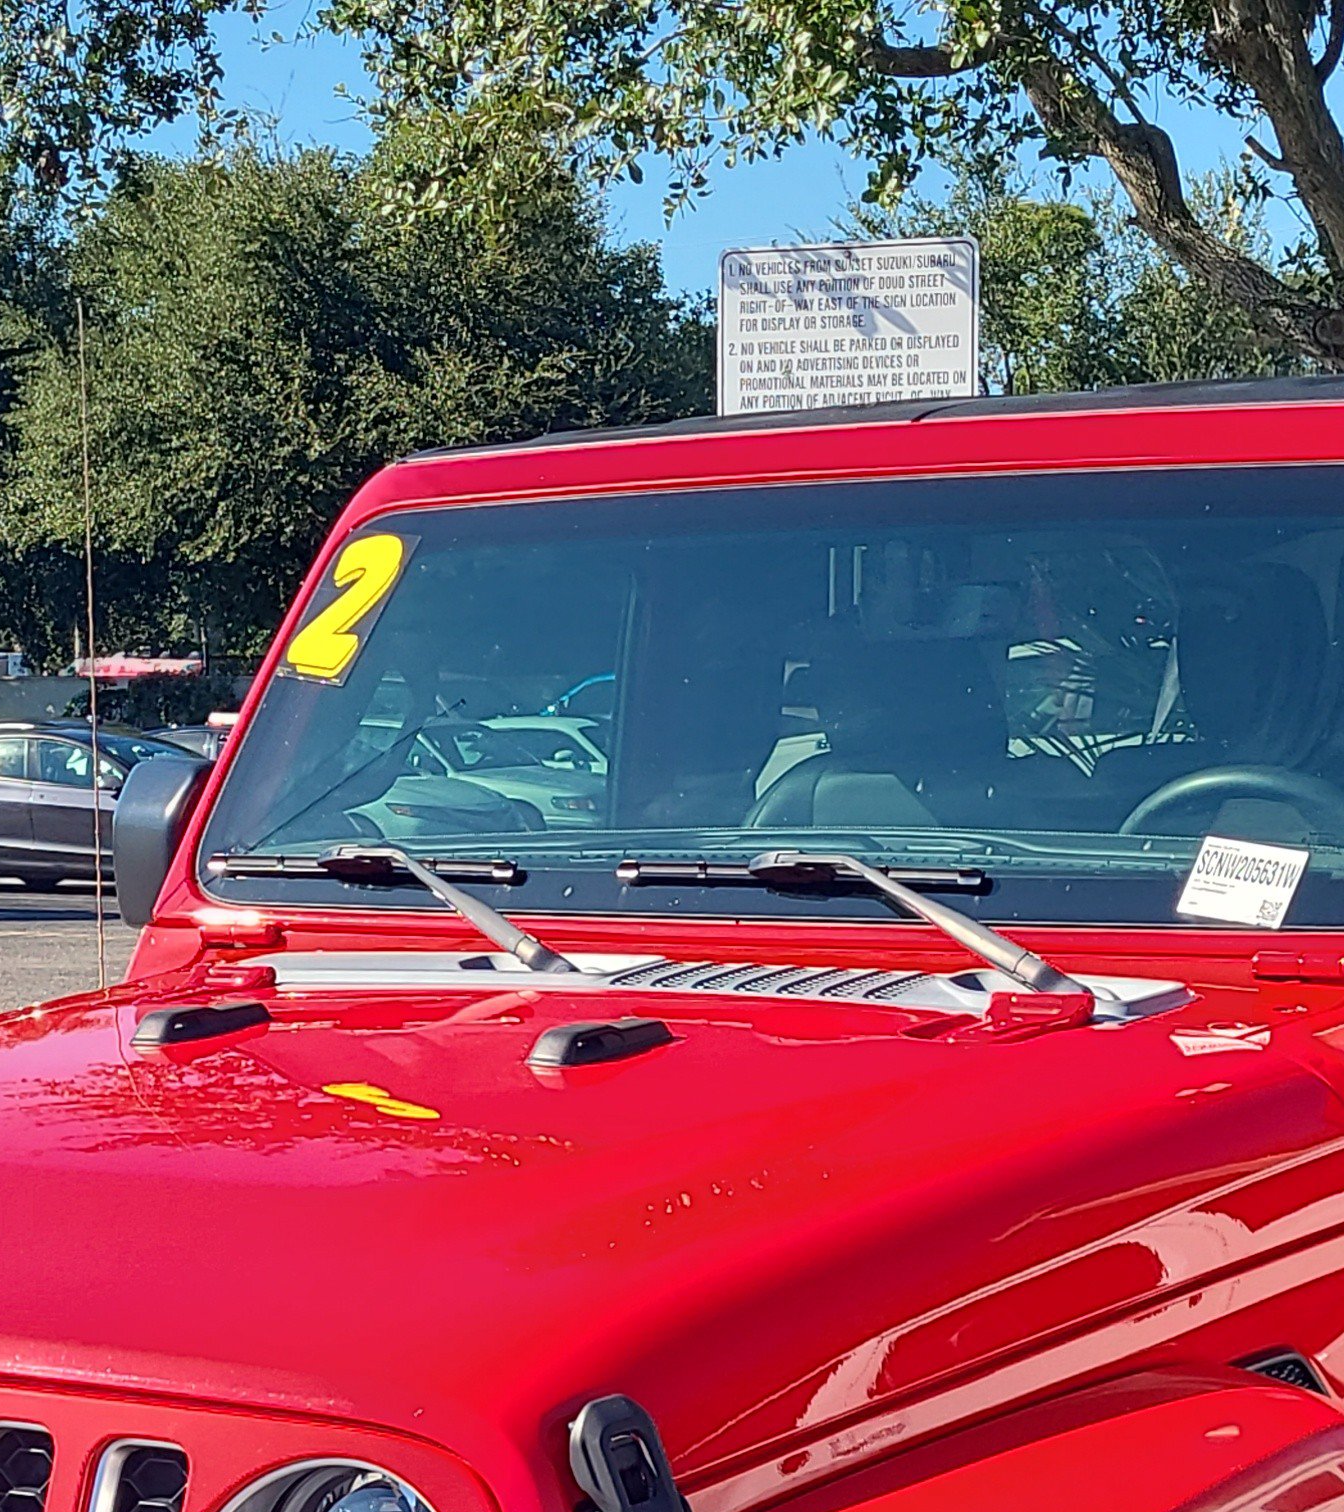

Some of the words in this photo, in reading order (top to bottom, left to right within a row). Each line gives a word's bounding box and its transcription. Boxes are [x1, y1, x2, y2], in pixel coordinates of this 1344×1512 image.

[739, 263, 752, 276] NO
[755, 260, 801, 275] VEHICLES
[803, 260, 831, 274] FROM
[834, 257, 873, 272] SUNSET
[740, 280, 771, 295] SHALL
[773, 280, 792, 294] USE
[796, 279, 815, 293] ANY
[819, 277, 859, 292] PORTION
[863, 276, 876, 290] OF
[878, 275, 905, 290] DOUD
[908, 274, 945, 288] STREET
[818, 297, 843, 311] EAST
[846, 296, 859, 310] OF
[862, 295, 880, 309] THE
[883, 294, 907, 308] SIGN
[910, 292, 956, 307] LOCATION
[740, 318, 758, 332] FOR
[761, 316, 801, 331] DISPLAY
[804, 316, 816, 330] OR
[729, 342, 737, 356] 2.
[741, 342, 754, 356] NO
[758, 340, 796, 355] VEHICLE
[800, 339, 829, 353] SHALL
[834, 338, 846, 352] BE
[849, 337, 887, 352] PARKED
[891, 336, 903, 350] OR
[907, 334, 960, 350] DISPLAYED
[740, 360, 753, 374] ON
[757, 359, 776, 373] AND
[779, 358, 793, 373] NO
[796, 356, 859, 371] ADVERTISING
[862, 354, 903, 369] DEVICES
[906, 353, 920, 368] OR
[740, 376, 806, 391] PROMOTIONAL
[810, 373, 864, 389] MATERIALS
[867, 372, 888, 387] MAY
[891, 372, 904, 386] BE
[907, 371, 949, 386] LOCATED
[953, 370, 967, 384] ON
[740, 395, 759, 410] ANY
[763, 394, 803, 409] PORTION
[806, 393, 819, 408] OF
[822, 391, 871, 406] ADJACENT
[286, 534, 403, 678] 2
[1197, 849, 1301, 889] SCNW205631W
